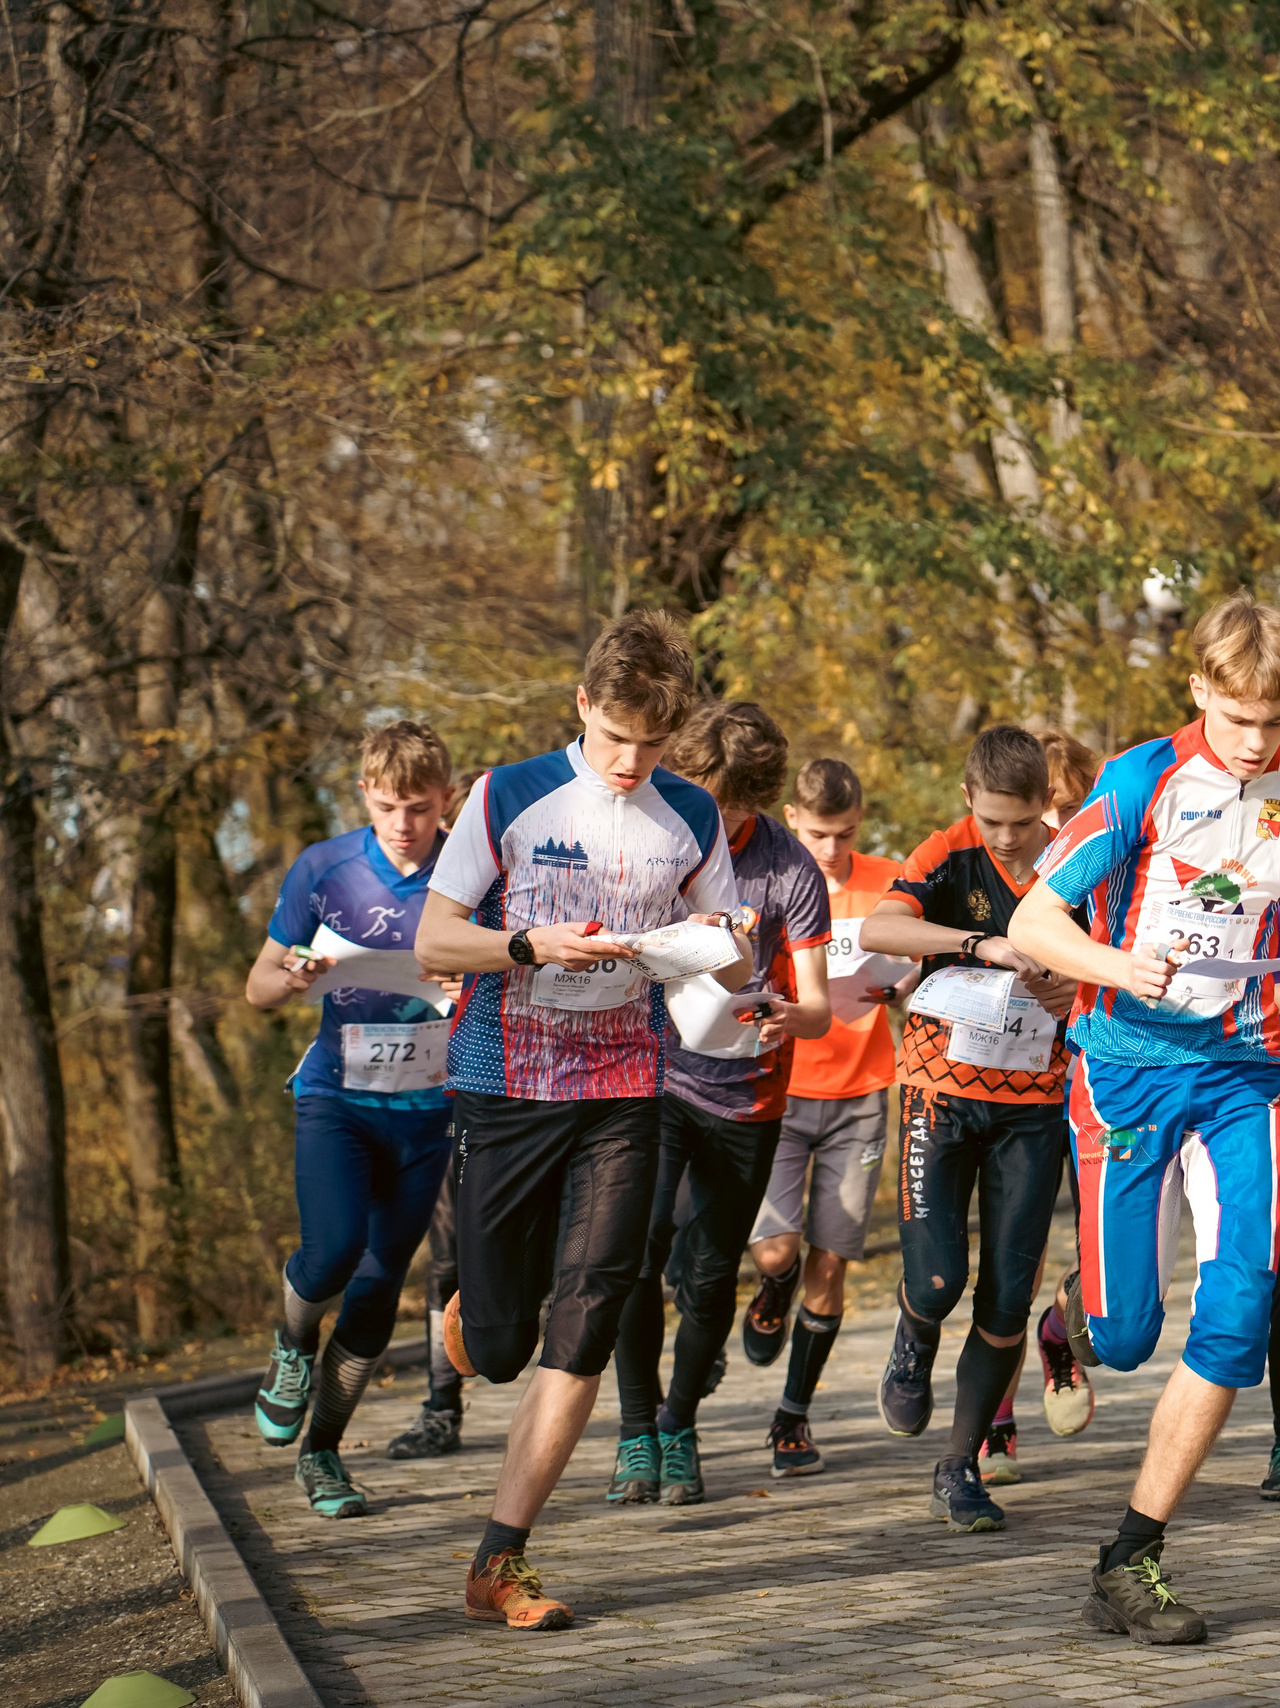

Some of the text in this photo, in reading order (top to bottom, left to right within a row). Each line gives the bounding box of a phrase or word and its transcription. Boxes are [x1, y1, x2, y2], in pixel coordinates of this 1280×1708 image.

[1169, 928, 1234, 959] 263 1
[554, 973, 592, 985] МЖ16
[917, 977, 937, 1002] 264.1
[969, 1031, 1000, 1046] МЖ16
[370, 1042, 431, 1063] 272 1
[1147, 1124, 1158, 1132] 18
